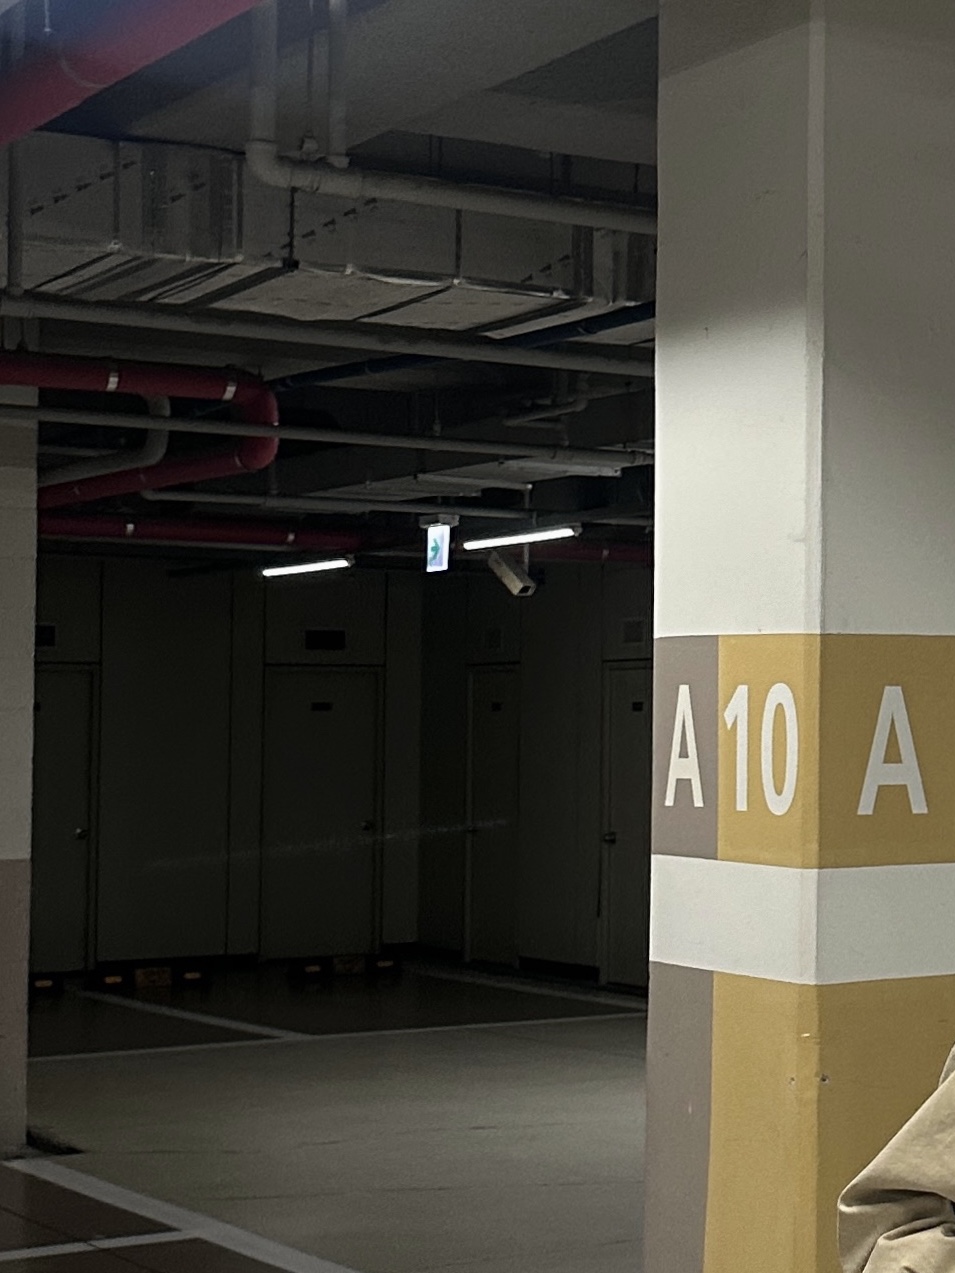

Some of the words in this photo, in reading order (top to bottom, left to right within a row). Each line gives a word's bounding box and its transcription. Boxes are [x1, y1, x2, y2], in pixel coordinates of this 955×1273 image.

[664, 684, 704, 808] A
[724, 683, 798, 815] 10
[857, 685, 928, 815] A
